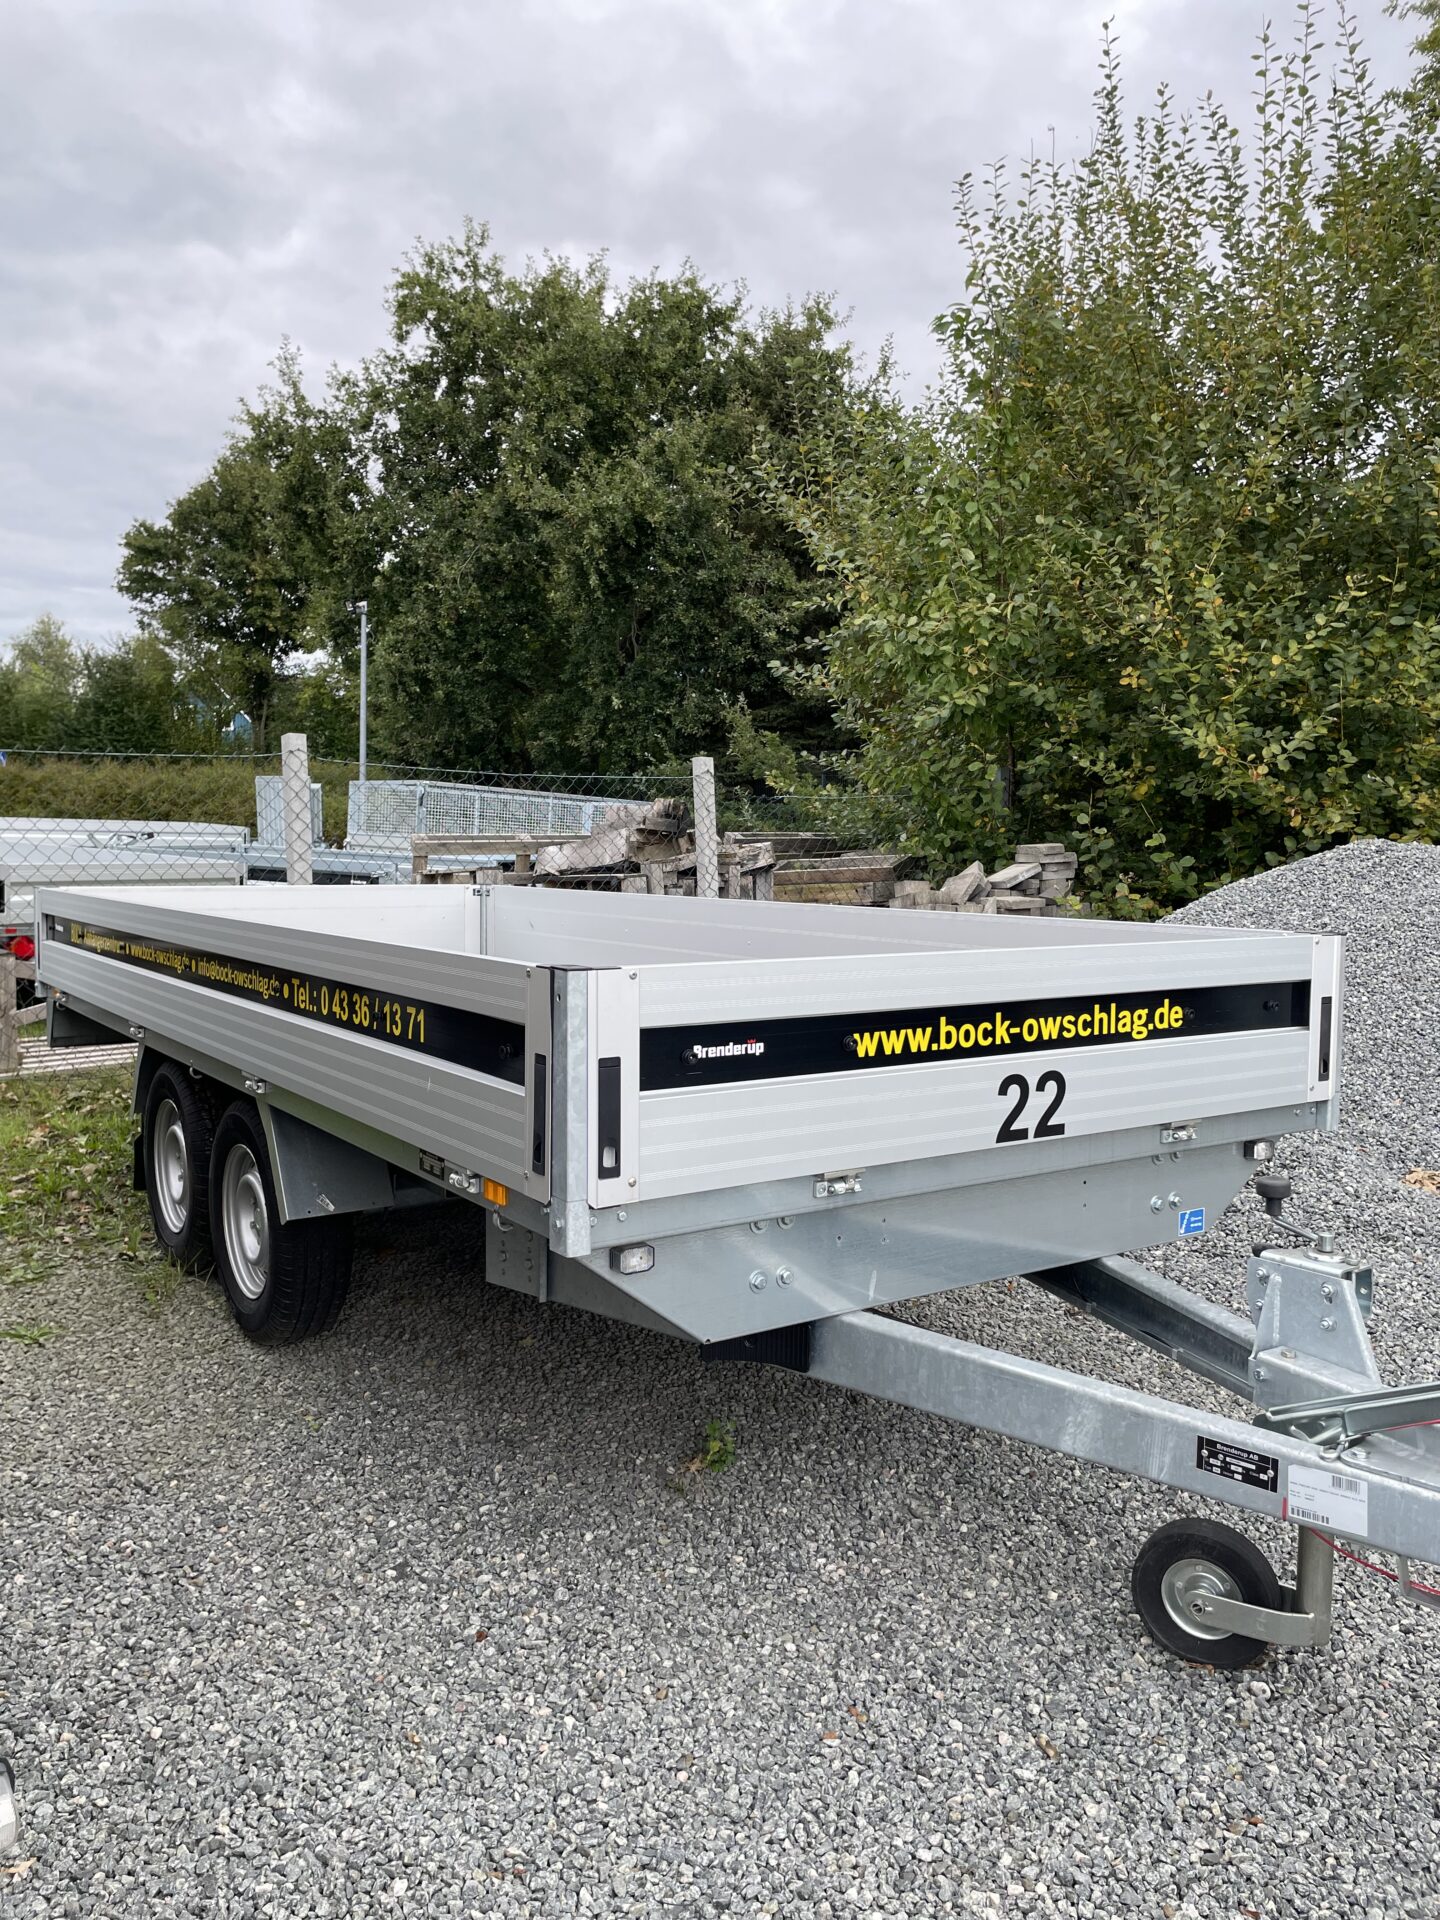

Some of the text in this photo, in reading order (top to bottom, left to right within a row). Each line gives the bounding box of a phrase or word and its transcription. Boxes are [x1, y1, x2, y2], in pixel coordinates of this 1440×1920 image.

[198, 957, 280, 999] info@bock-owschlag.de
[292, 978, 317, 1012] Tel.:
[321, 985, 329, 1016] 0
[332, 988, 349, 1021] 43
[352, 993, 370, 1027] 36
[384, 1000, 402, 1036] 13
[406, 1006, 425, 1043] 71
[854, 998, 1184, 1058] www.bock-owschlag.de
[996, 1070, 1067, 1144] 22
[1216, 1443, 1259, 1461] Brenderup AB
